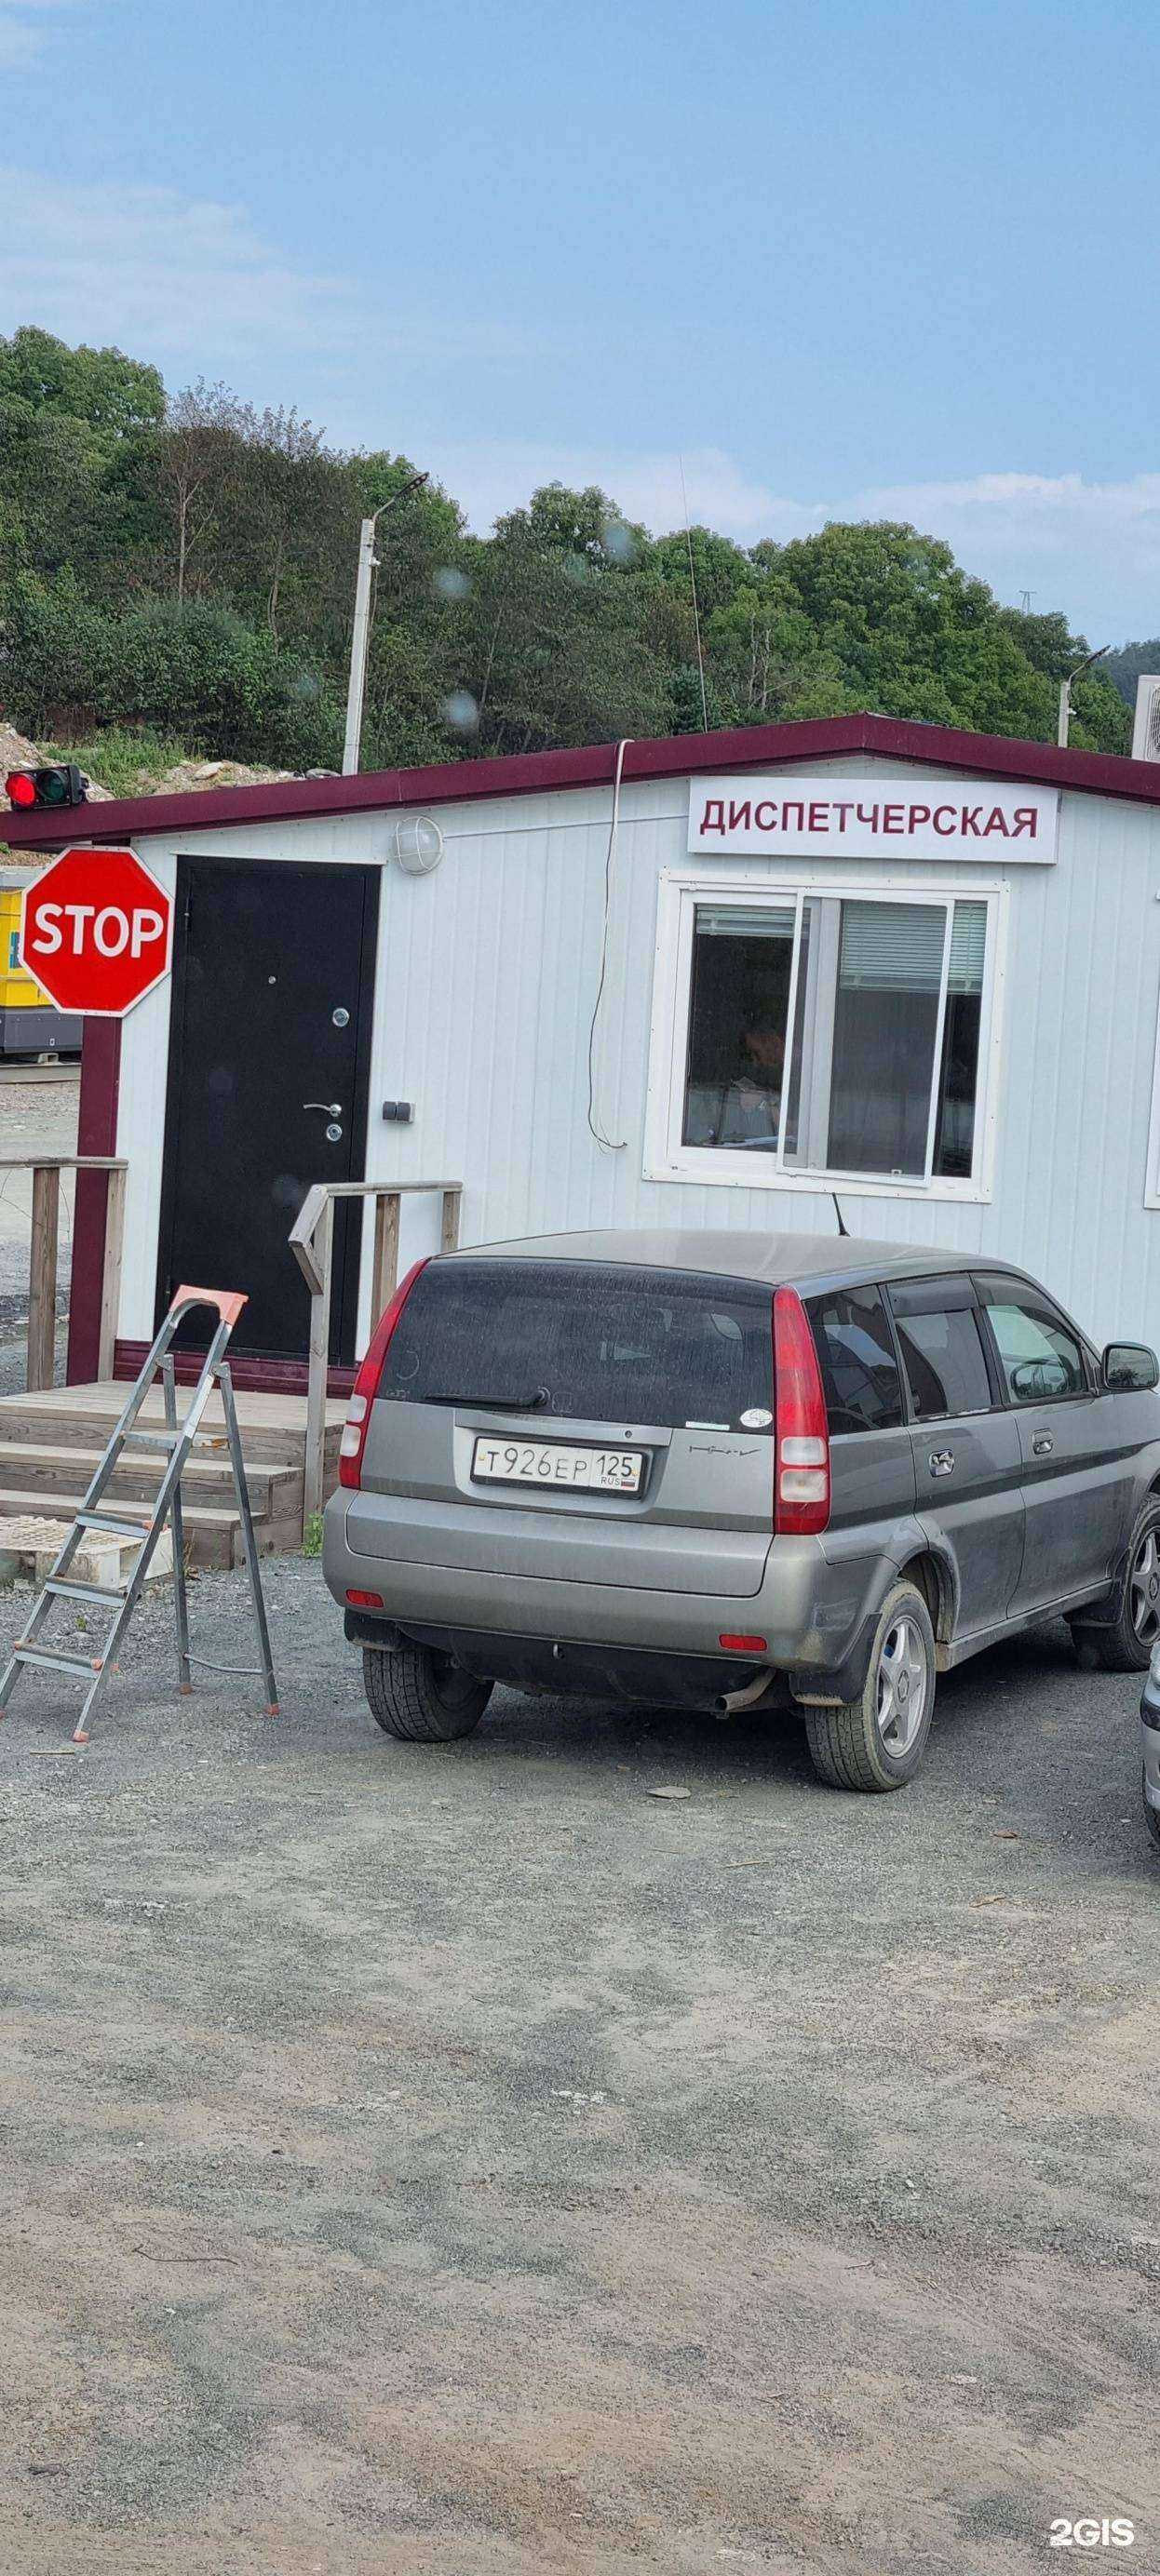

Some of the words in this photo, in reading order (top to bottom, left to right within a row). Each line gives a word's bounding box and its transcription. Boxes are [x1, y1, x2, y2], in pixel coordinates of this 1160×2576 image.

[699, 799, 1039, 839] ДИСПЕТЧЕРСКАЯ
[31, 903, 165, 959] STOP
[600, 1476, 621, 1486] RUS
